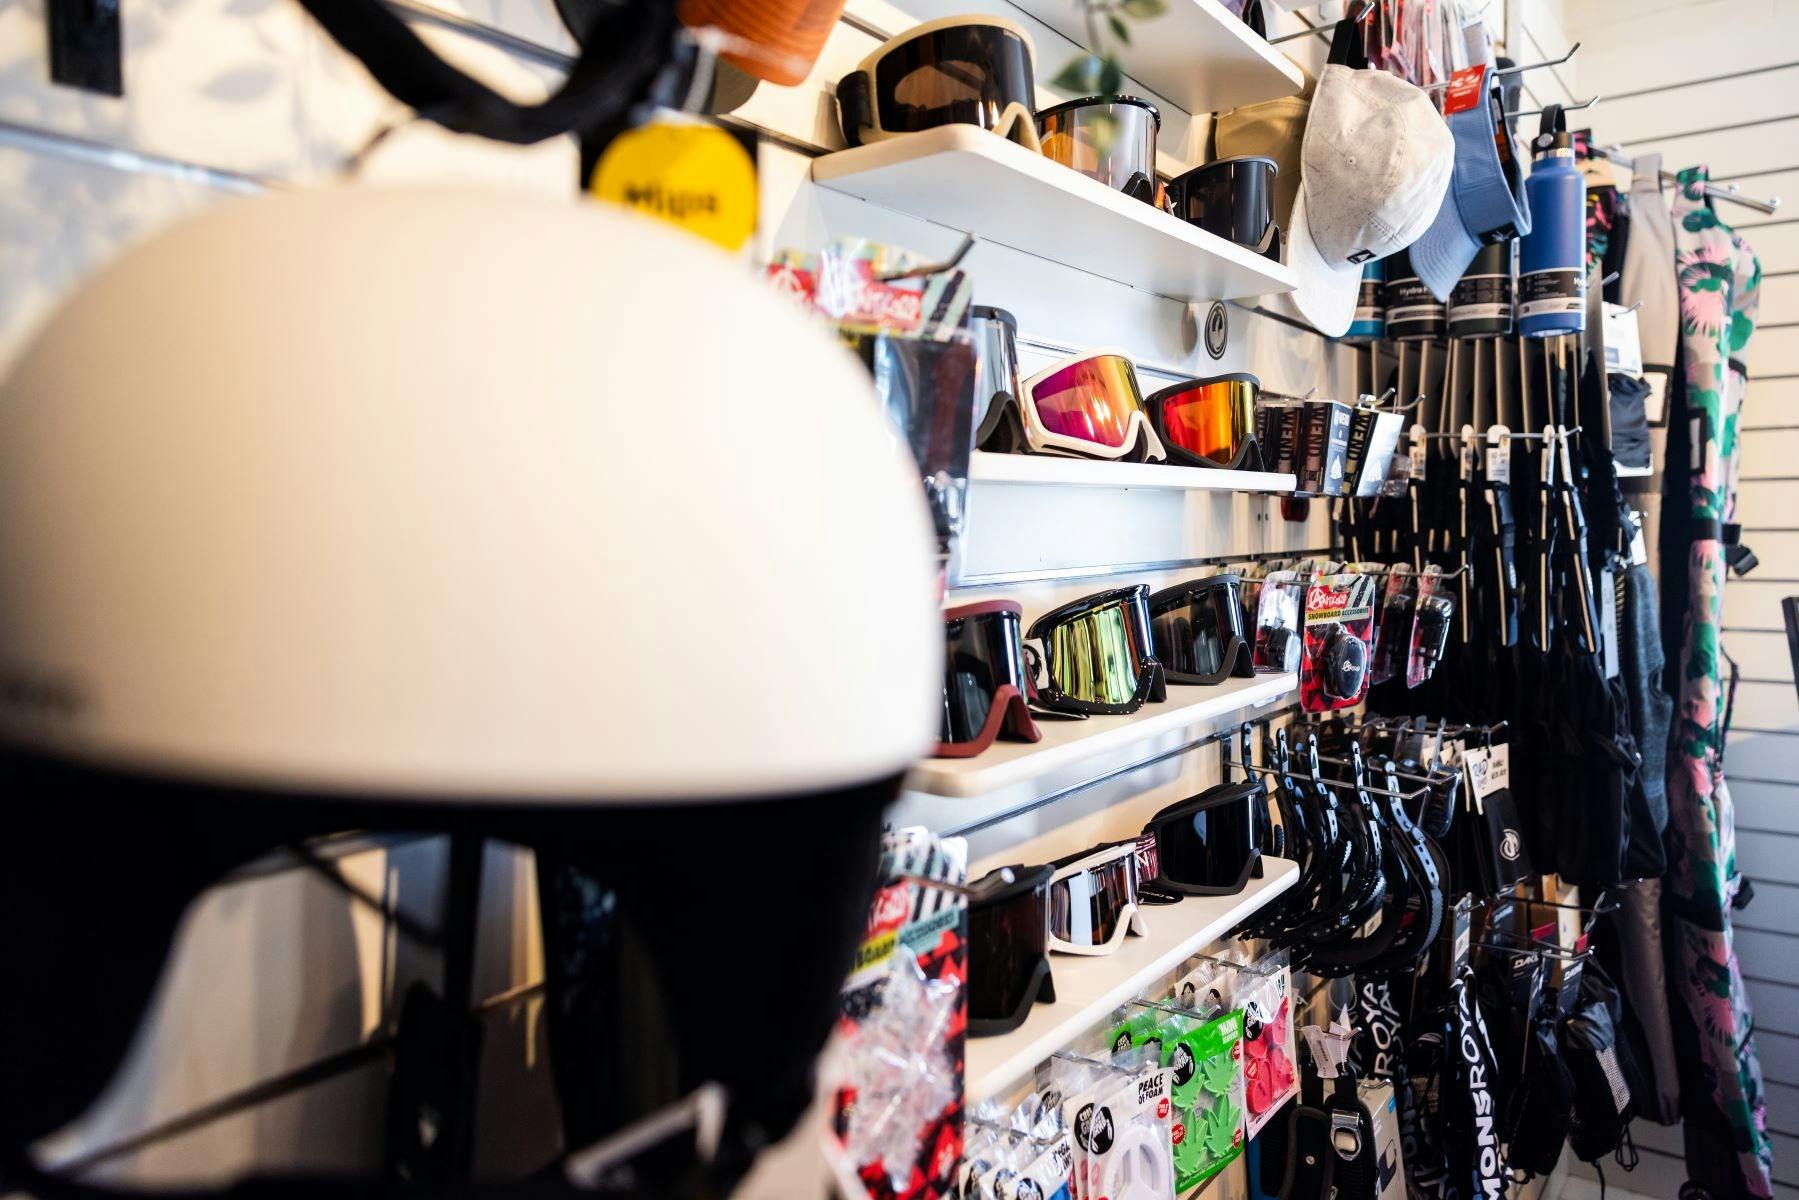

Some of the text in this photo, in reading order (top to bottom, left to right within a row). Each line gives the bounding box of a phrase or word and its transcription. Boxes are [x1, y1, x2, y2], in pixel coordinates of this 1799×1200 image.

[1308, 607, 1369, 620] SNOWBOARD ACCESSORIES
[1138, 1073, 1164, 1095] PEACE
[1138, 1086, 1164, 1105] OF FOAM
